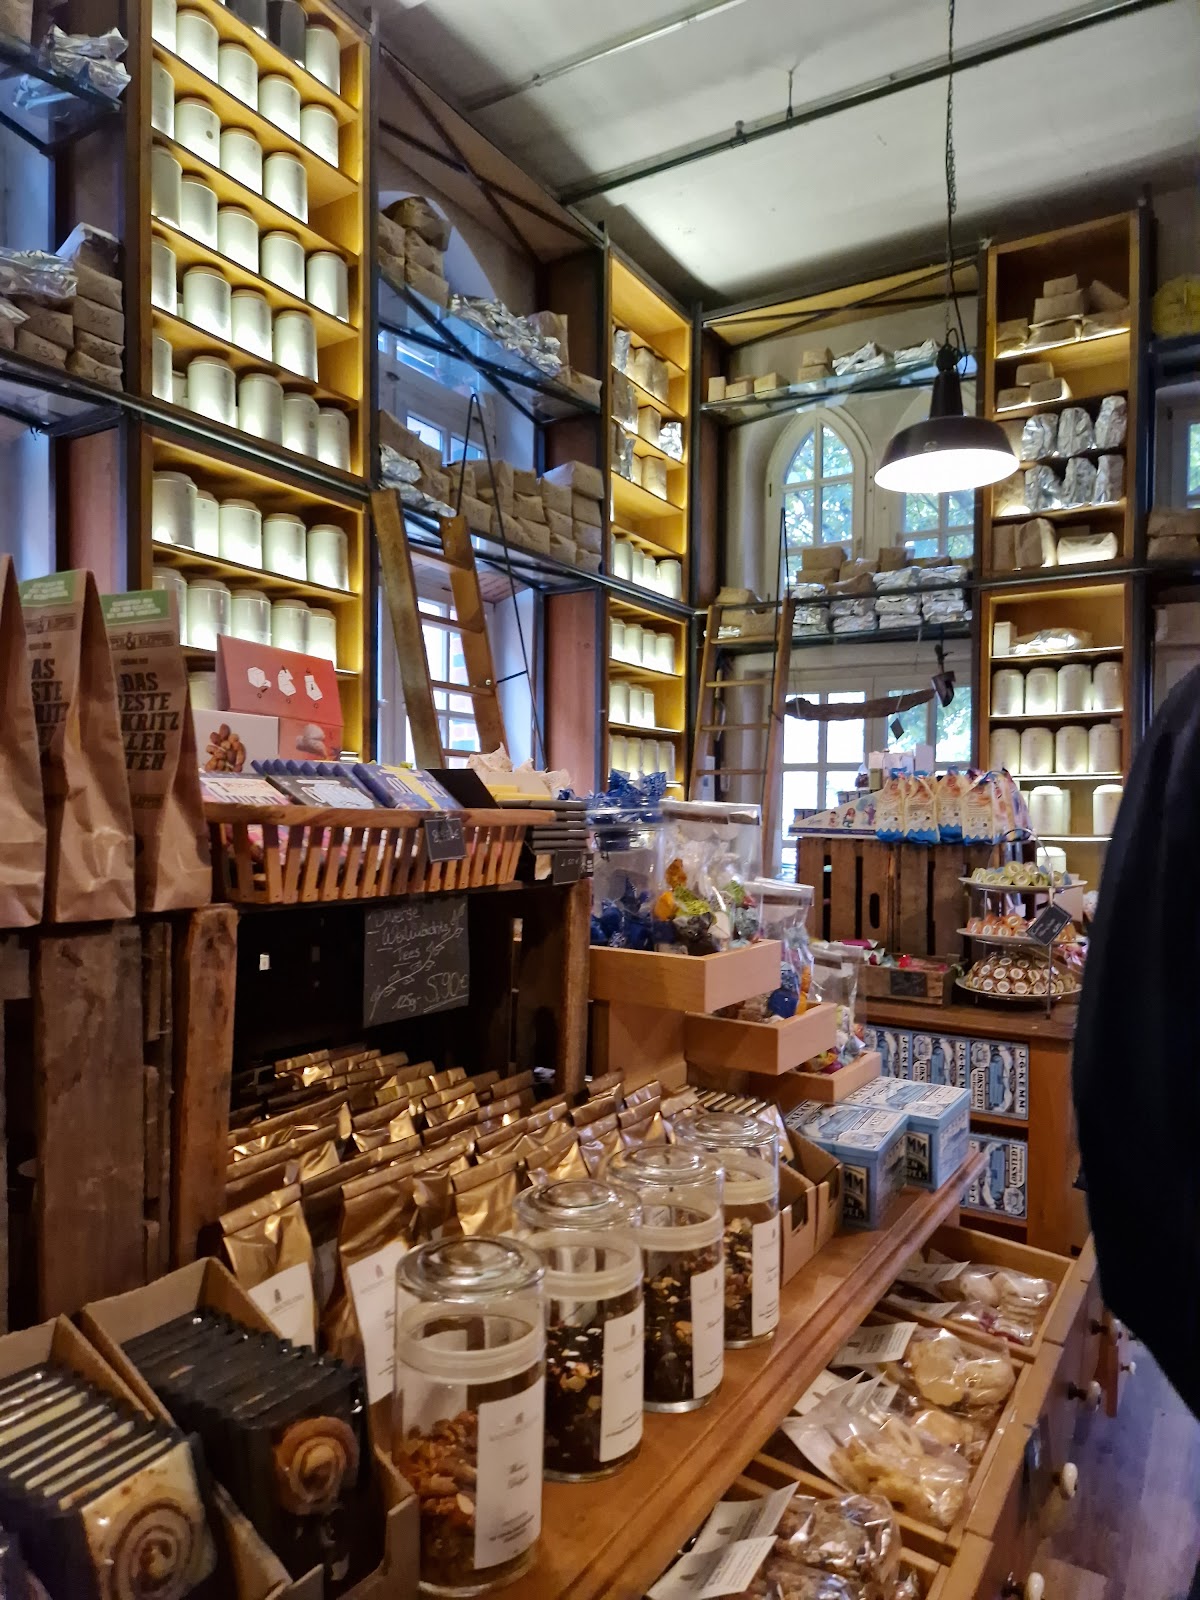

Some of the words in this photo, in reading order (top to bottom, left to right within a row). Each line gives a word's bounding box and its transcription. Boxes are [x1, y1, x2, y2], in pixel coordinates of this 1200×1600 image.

[120, 672, 158, 692] DAS
[393, 943, 421, 963] Tees
[976, 1069, 986, 1110] LOKSTEDT
